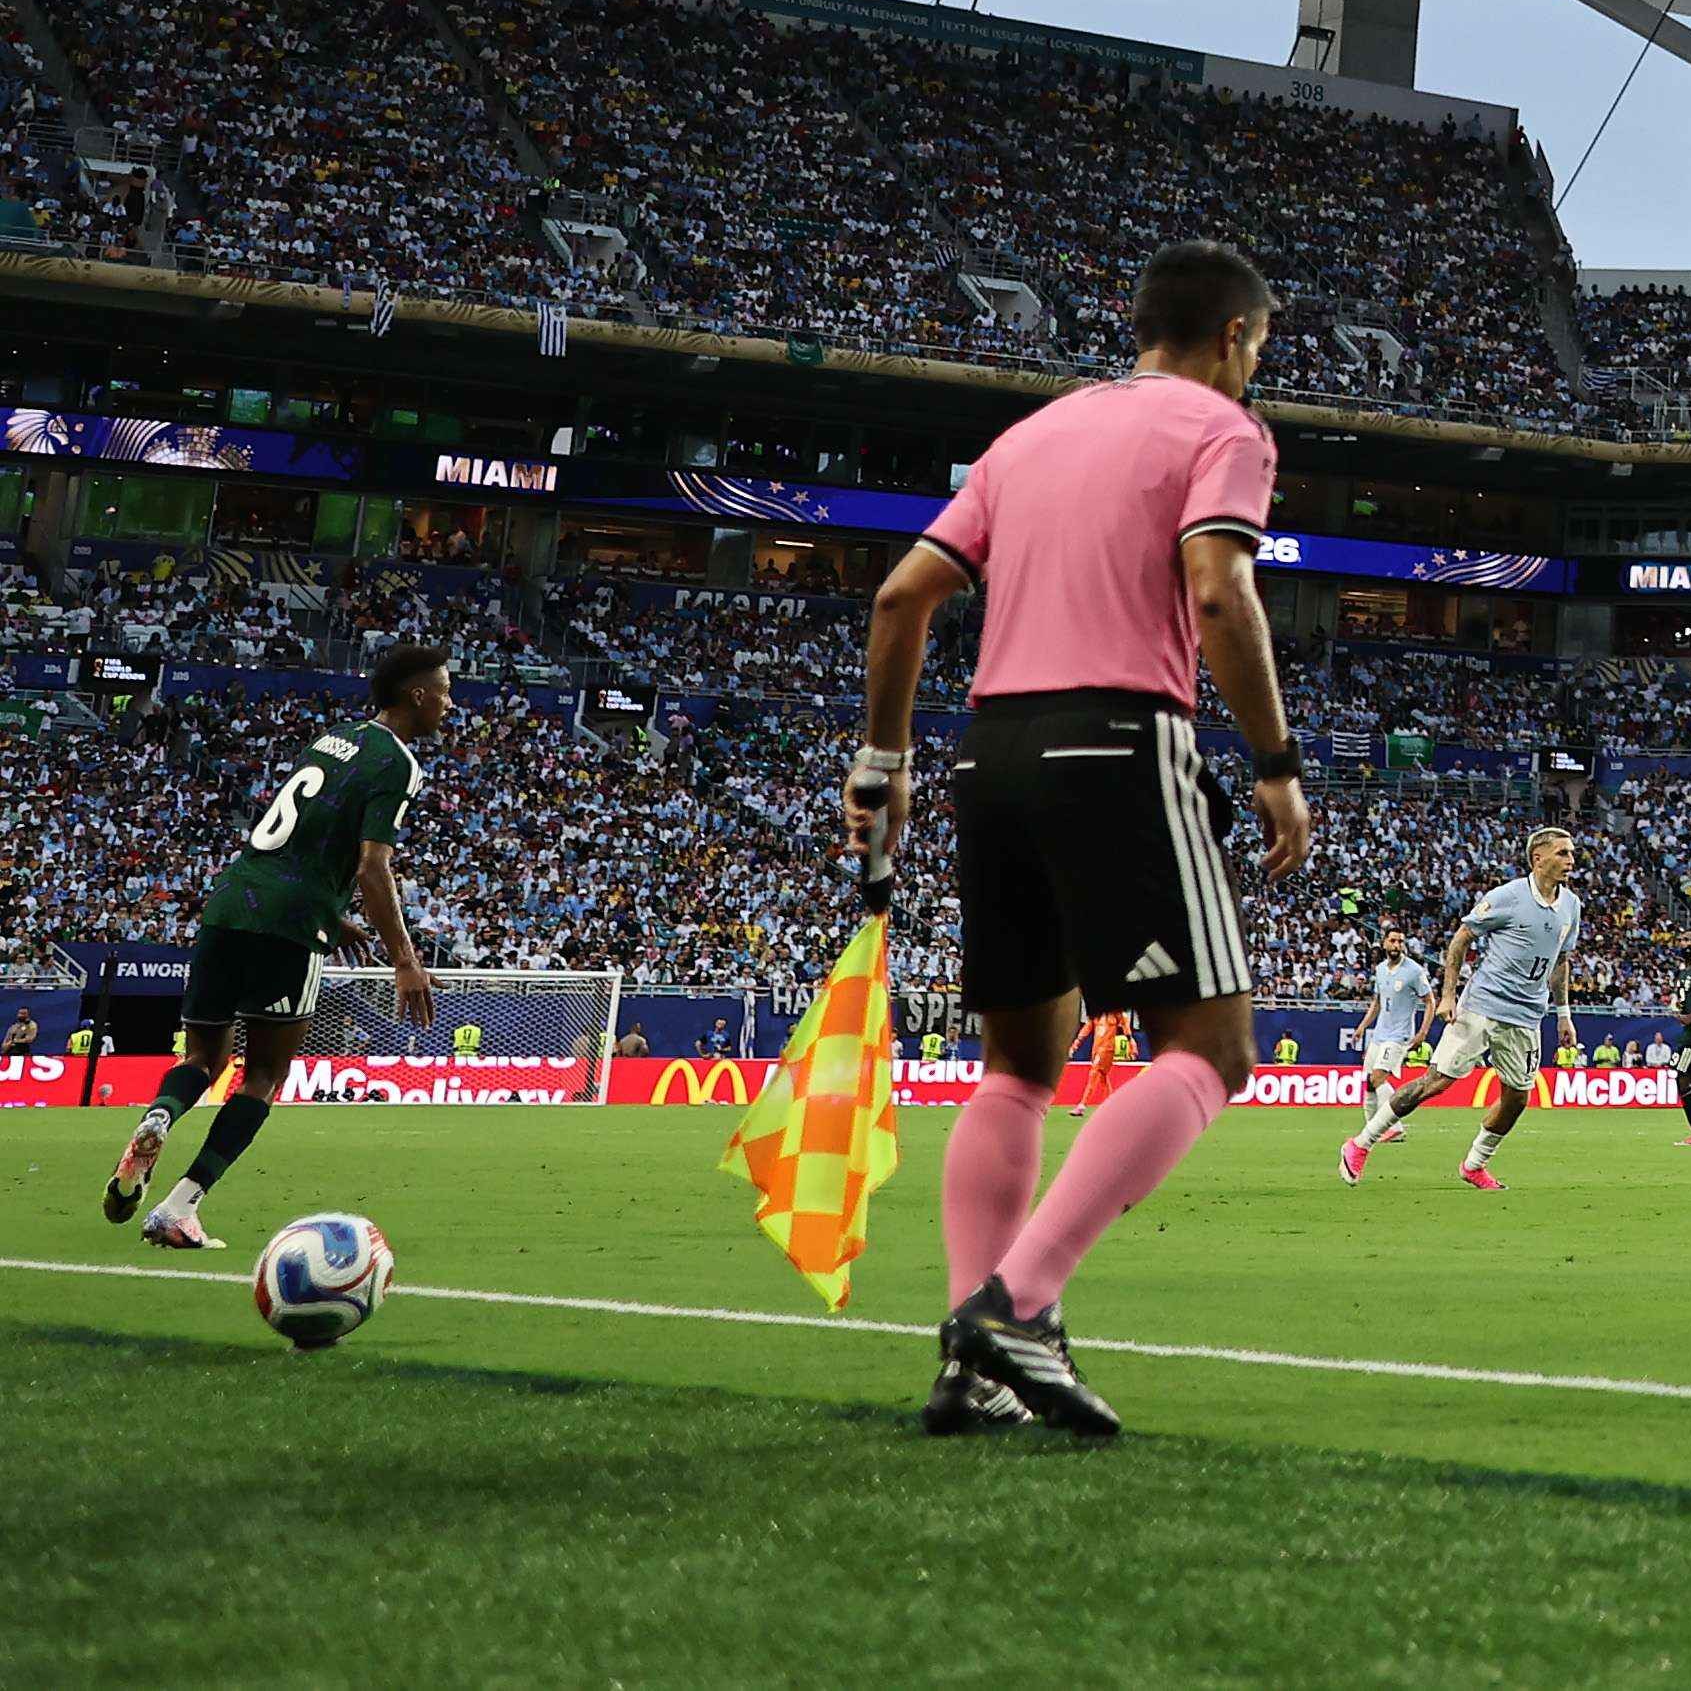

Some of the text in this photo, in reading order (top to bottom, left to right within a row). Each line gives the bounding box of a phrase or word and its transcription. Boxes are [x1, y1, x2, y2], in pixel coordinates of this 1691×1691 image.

[1291, 81, 1324, 101] 308
[435, 454, 558, 491] MIAMI
[1529, 956, 1550, 982] 13
